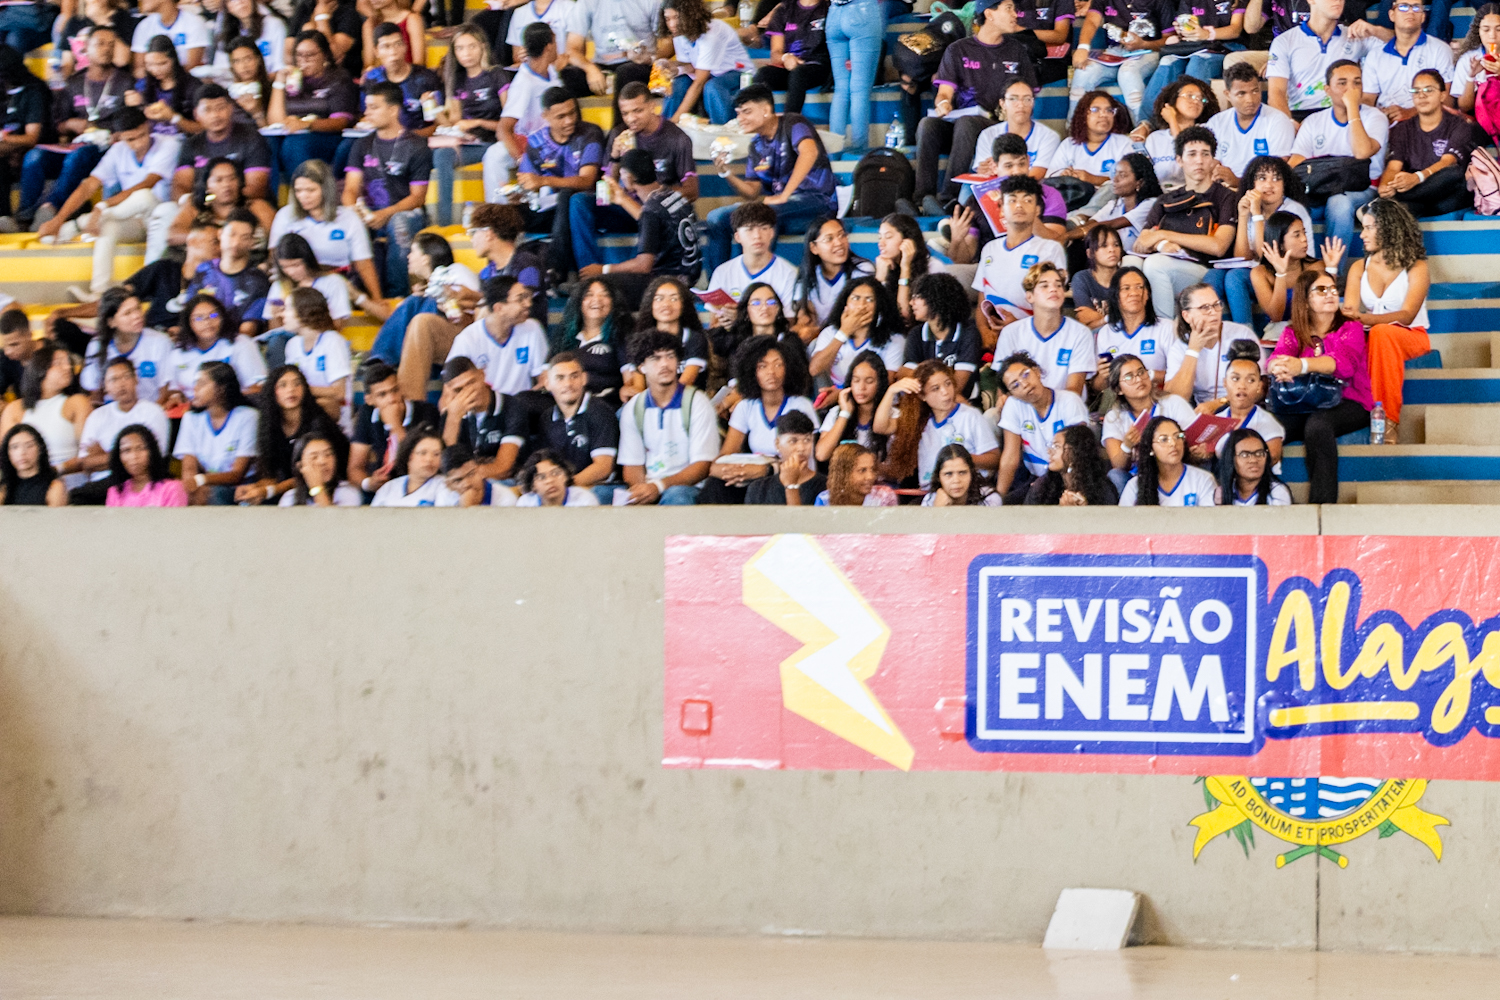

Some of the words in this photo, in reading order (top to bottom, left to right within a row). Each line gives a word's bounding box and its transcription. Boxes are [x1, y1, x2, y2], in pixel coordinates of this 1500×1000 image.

[1000, 586, 1233, 644] REVISÃO
[999, 653, 1230, 722] ENEM
[1230, 780, 1247, 799] AD
[1245, 799, 1292, 834] BONUM
[1295, 826, 1313, 840] ET
[1319, 779, 1408, 841] PROSPERITATEM
